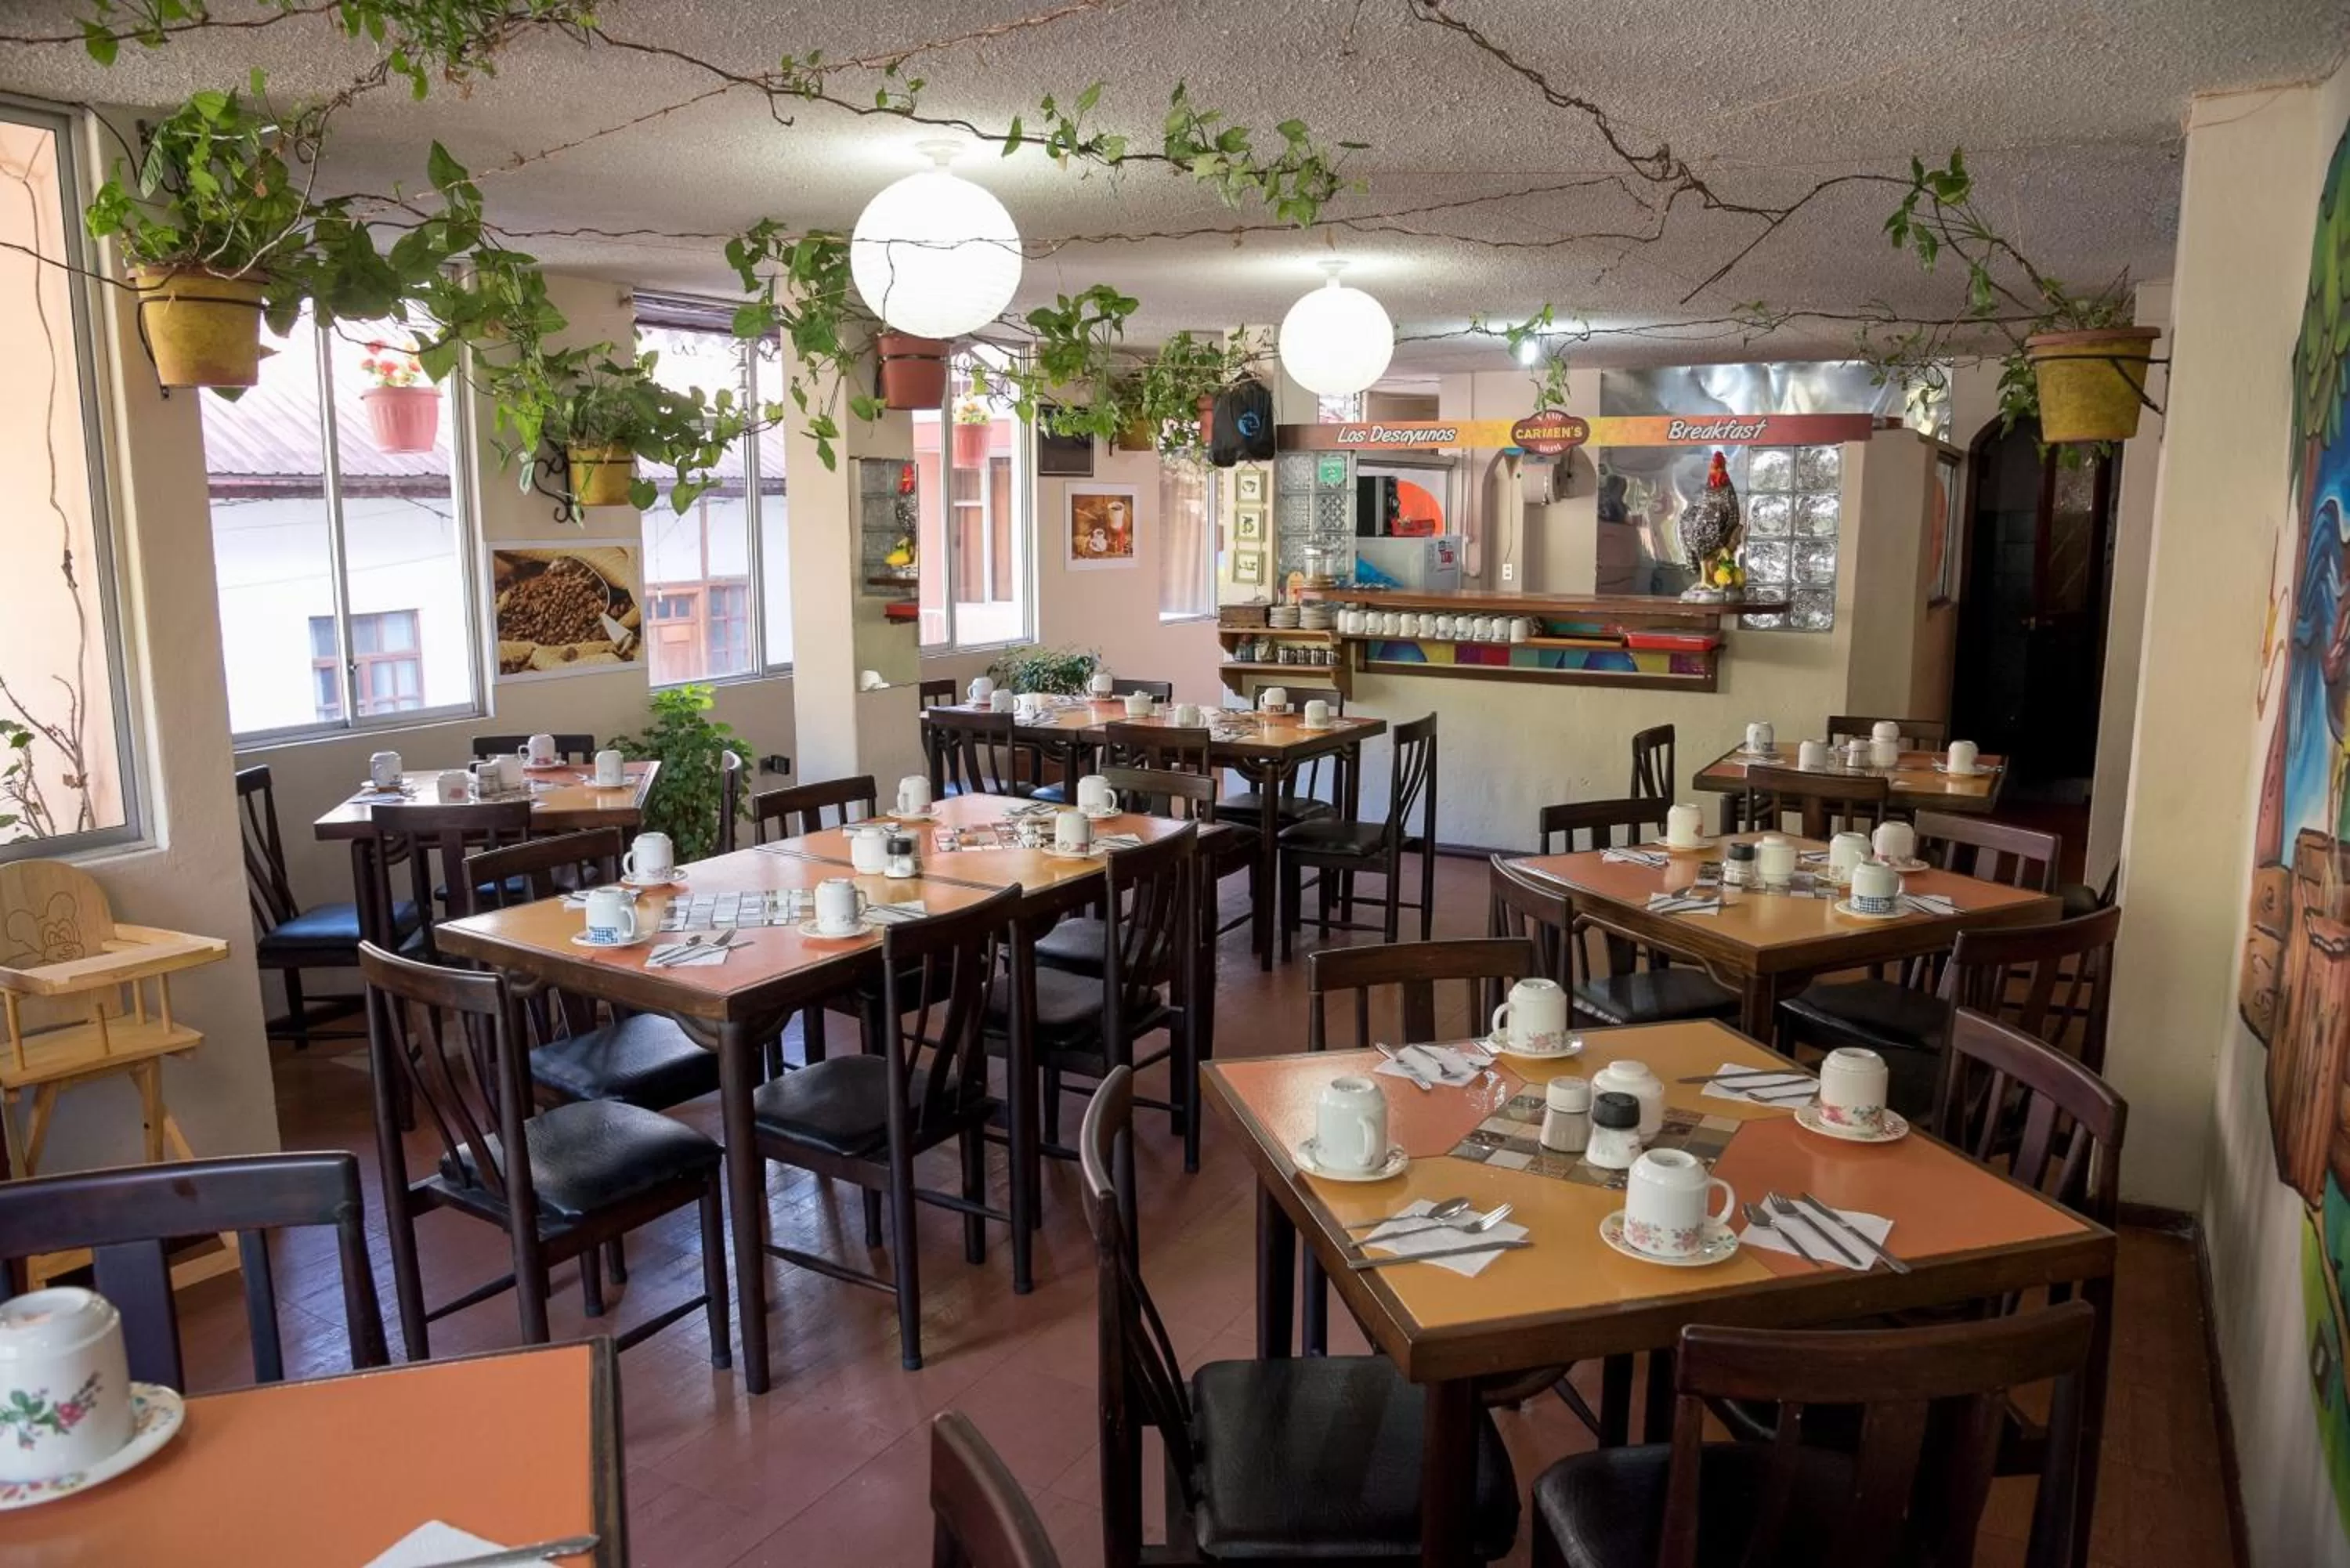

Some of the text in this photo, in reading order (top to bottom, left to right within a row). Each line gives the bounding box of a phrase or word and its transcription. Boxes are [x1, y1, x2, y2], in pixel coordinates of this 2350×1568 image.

[1337, 425, 1456, 446] Los Desayunos
[1516, 425, 1582, 439] CARMEN'S
[1668, 418, 1767, 439] Breakfast
